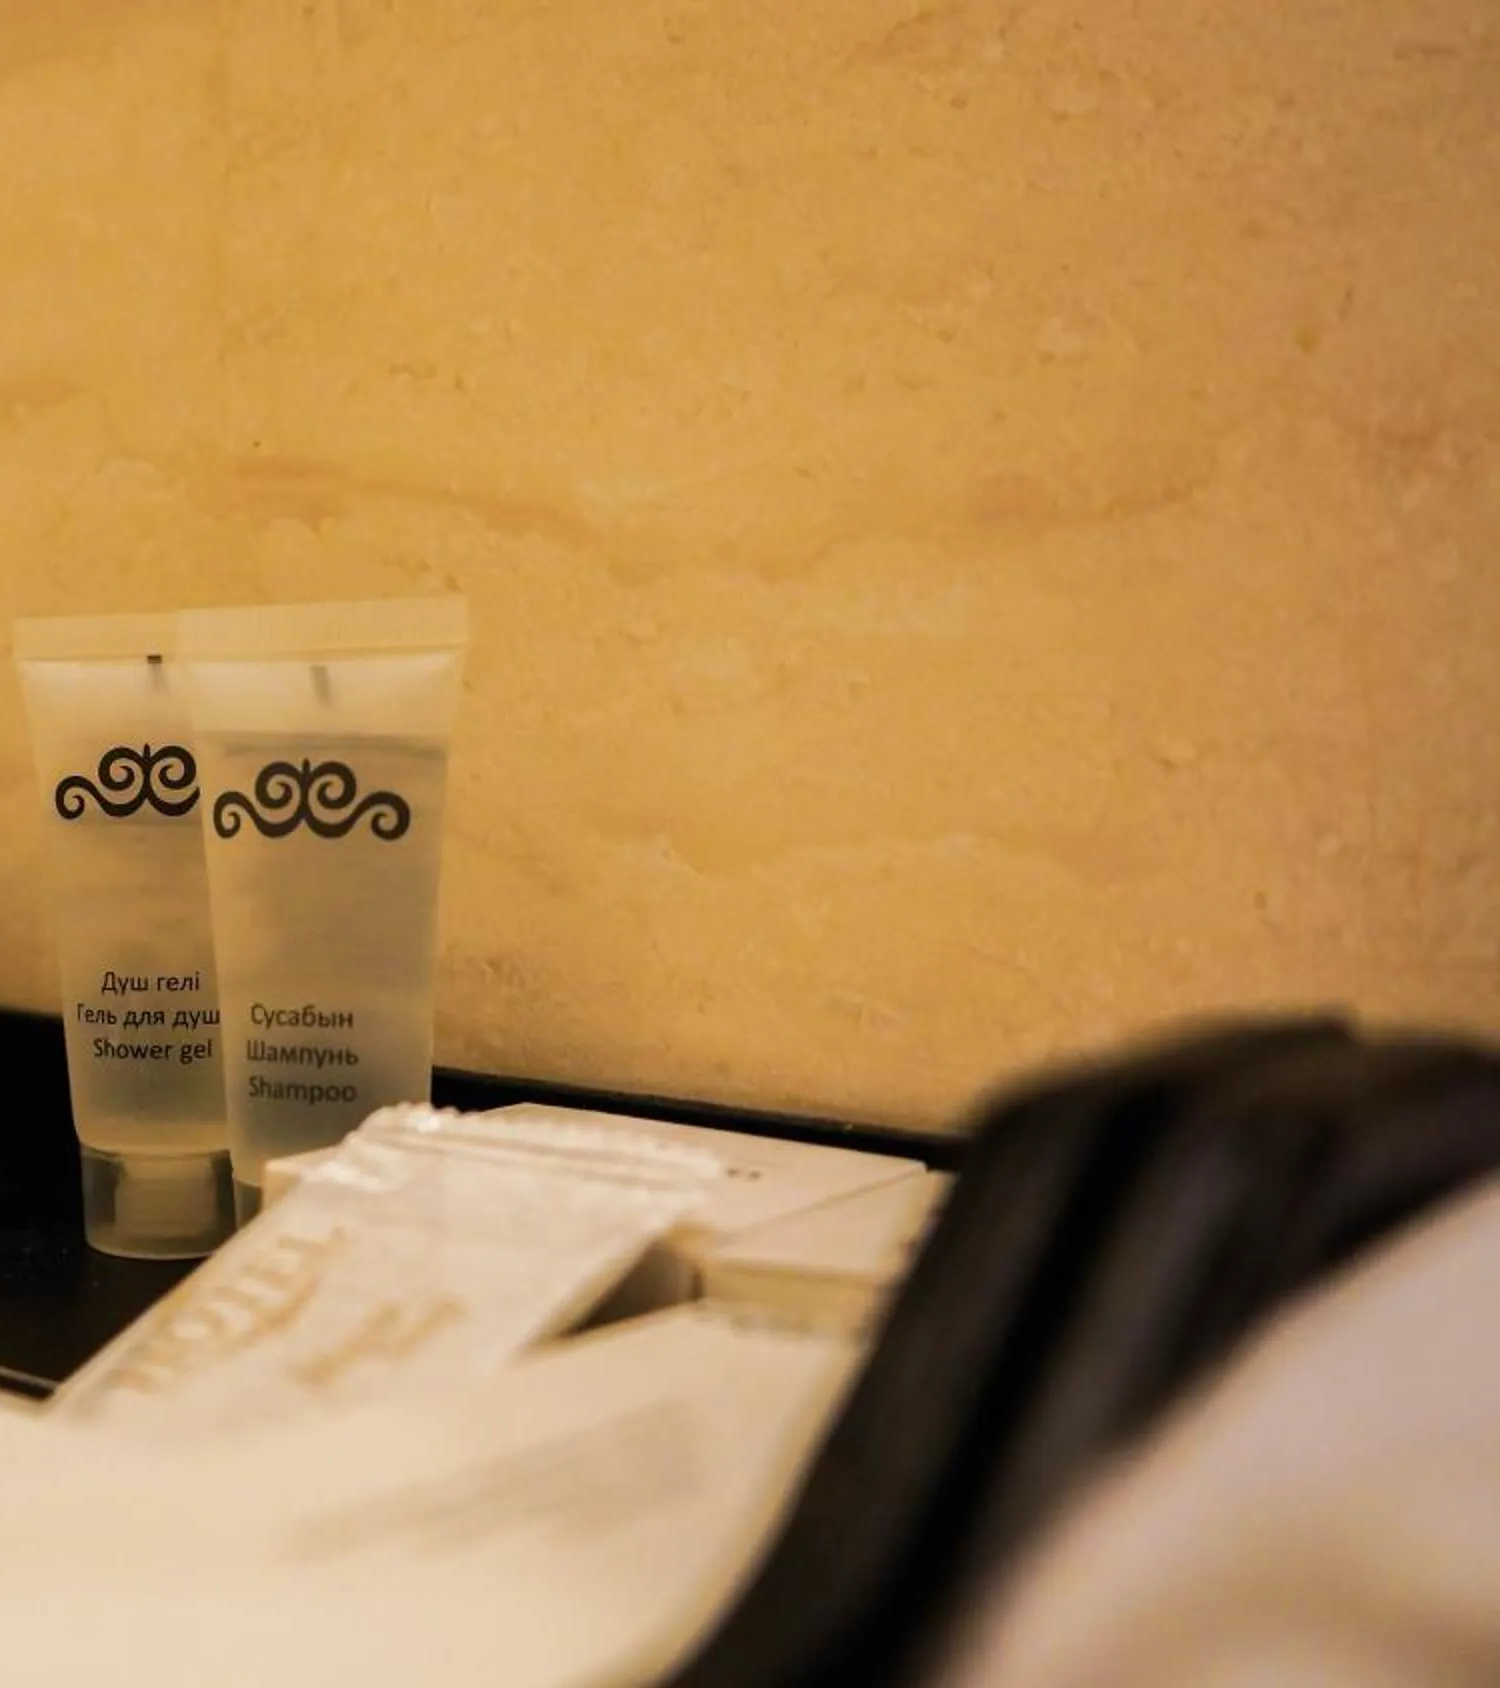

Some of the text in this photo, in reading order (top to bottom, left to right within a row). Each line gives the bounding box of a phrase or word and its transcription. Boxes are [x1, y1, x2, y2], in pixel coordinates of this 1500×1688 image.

[101, 971, 200, 996] Душ гелі
[76, 1003, 220, 1031] Гель для душ
[250, 1002, 354, 1030] Сусабын
[93, 1037, 213, 1066] Shower gel
[246, 1039, 359, 1070] Шампунь
[248, 1075, 358, 1105] Shampoo
